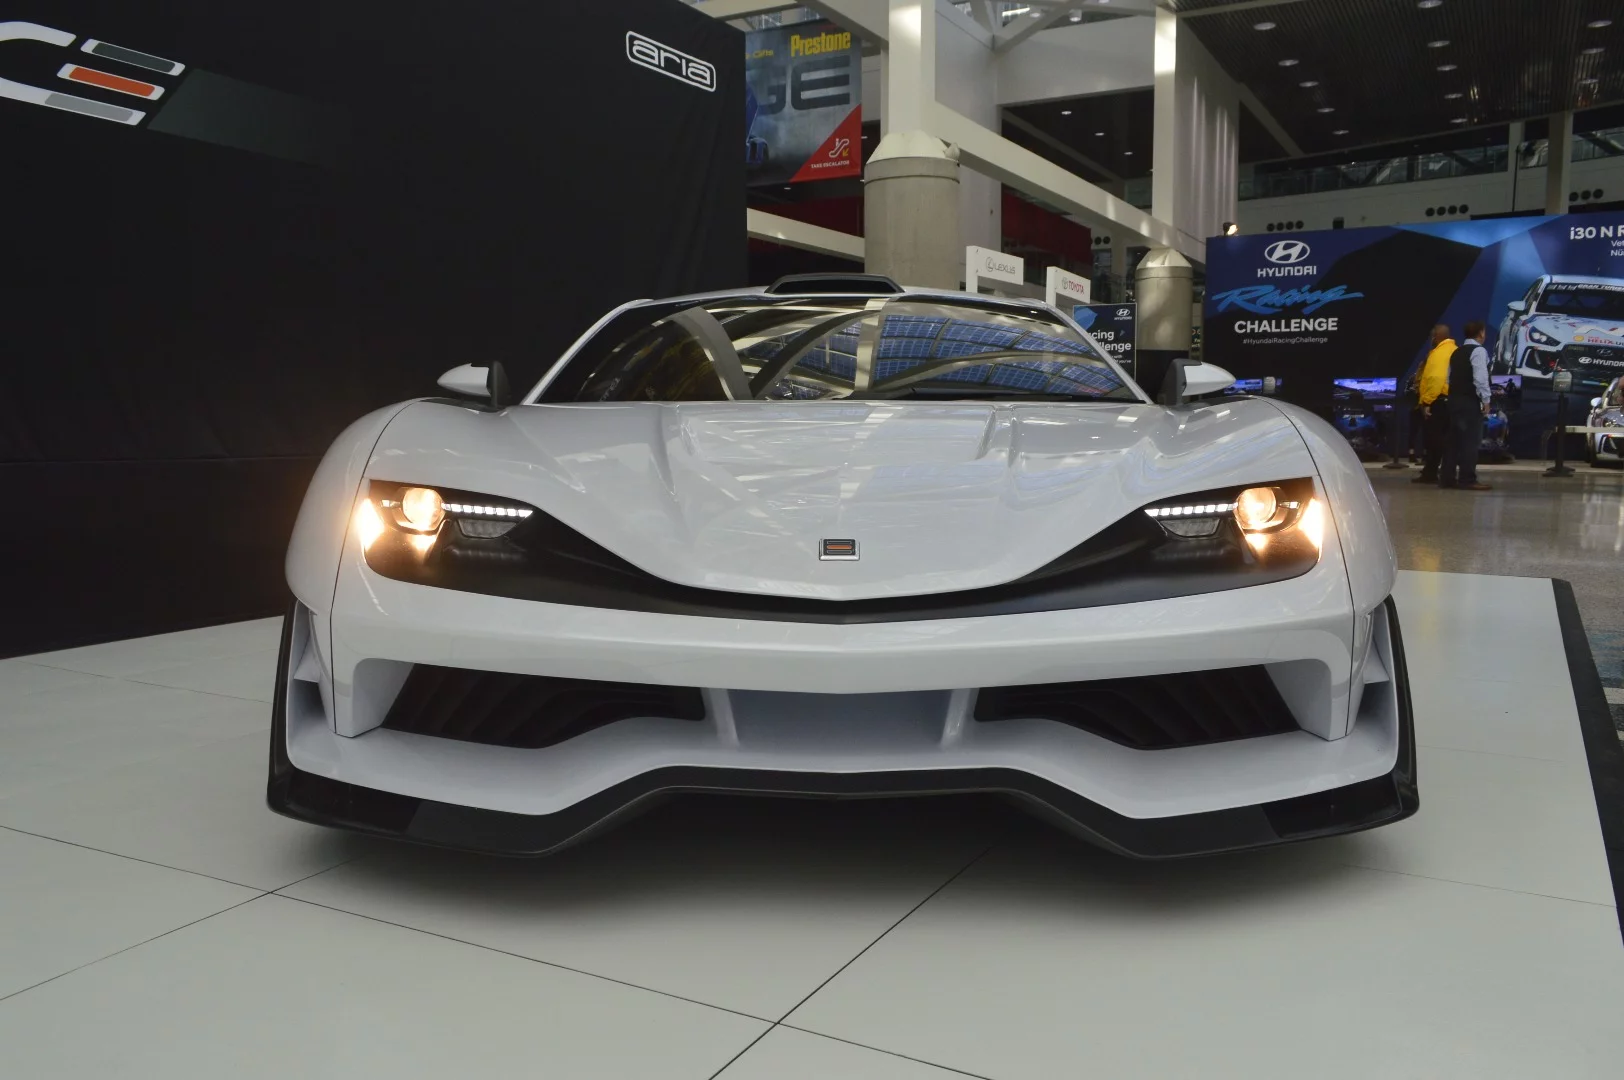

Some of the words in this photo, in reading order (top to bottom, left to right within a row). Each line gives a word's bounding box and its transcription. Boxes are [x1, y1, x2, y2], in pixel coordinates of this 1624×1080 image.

[790, 31, 851, 57] Prestone
[633, 40, 711, 85] aria
[823, 160, 850, 168] ESCALATOR
[1570, 226, 1596, 240] i30
[1600, 226, 1614, 238] N
[994, 263, 1016, 274] LEXUS
[1257, 265, 1317, 277] HYUNDAI
[1068, 280, 1085, 294] TOYOTA
[1211, 284, 1365, 315] Racing
[1234, 317, 1339, 334] CHALLENGE
[1242, 336, 1328, 346] #HyundaiRacingChallenge
